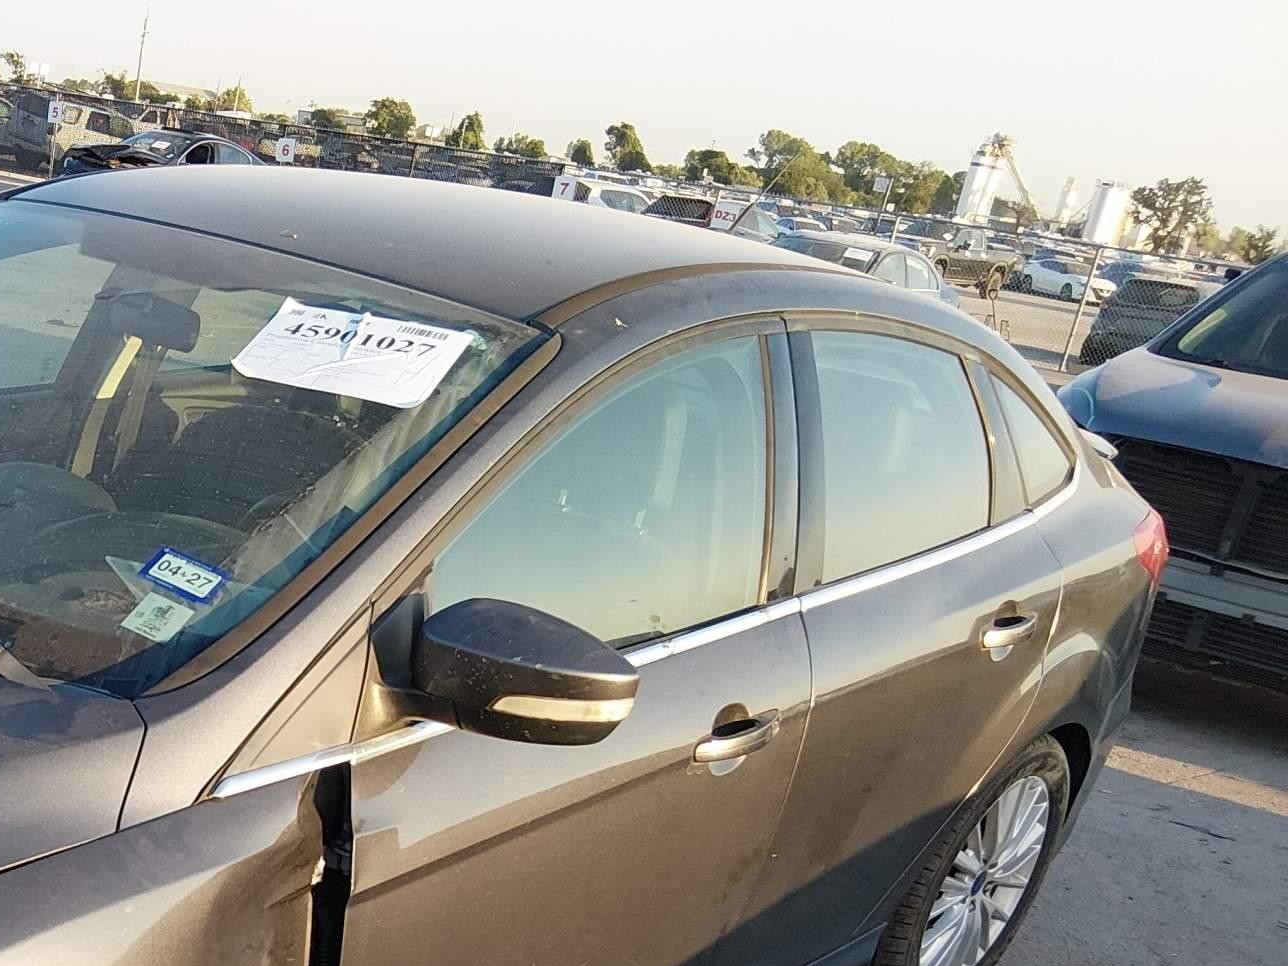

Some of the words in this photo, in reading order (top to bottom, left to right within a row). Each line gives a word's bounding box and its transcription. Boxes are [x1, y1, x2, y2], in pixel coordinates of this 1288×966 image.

[52, 107, 59, 118] 5
[282, 144, 290, 156] 6
[560, 182, 570, 195] 7
[284, 321, 437, 357] 45901027
[157, 559, 183, 577] 04
[185, 572, 214, 589] 27
